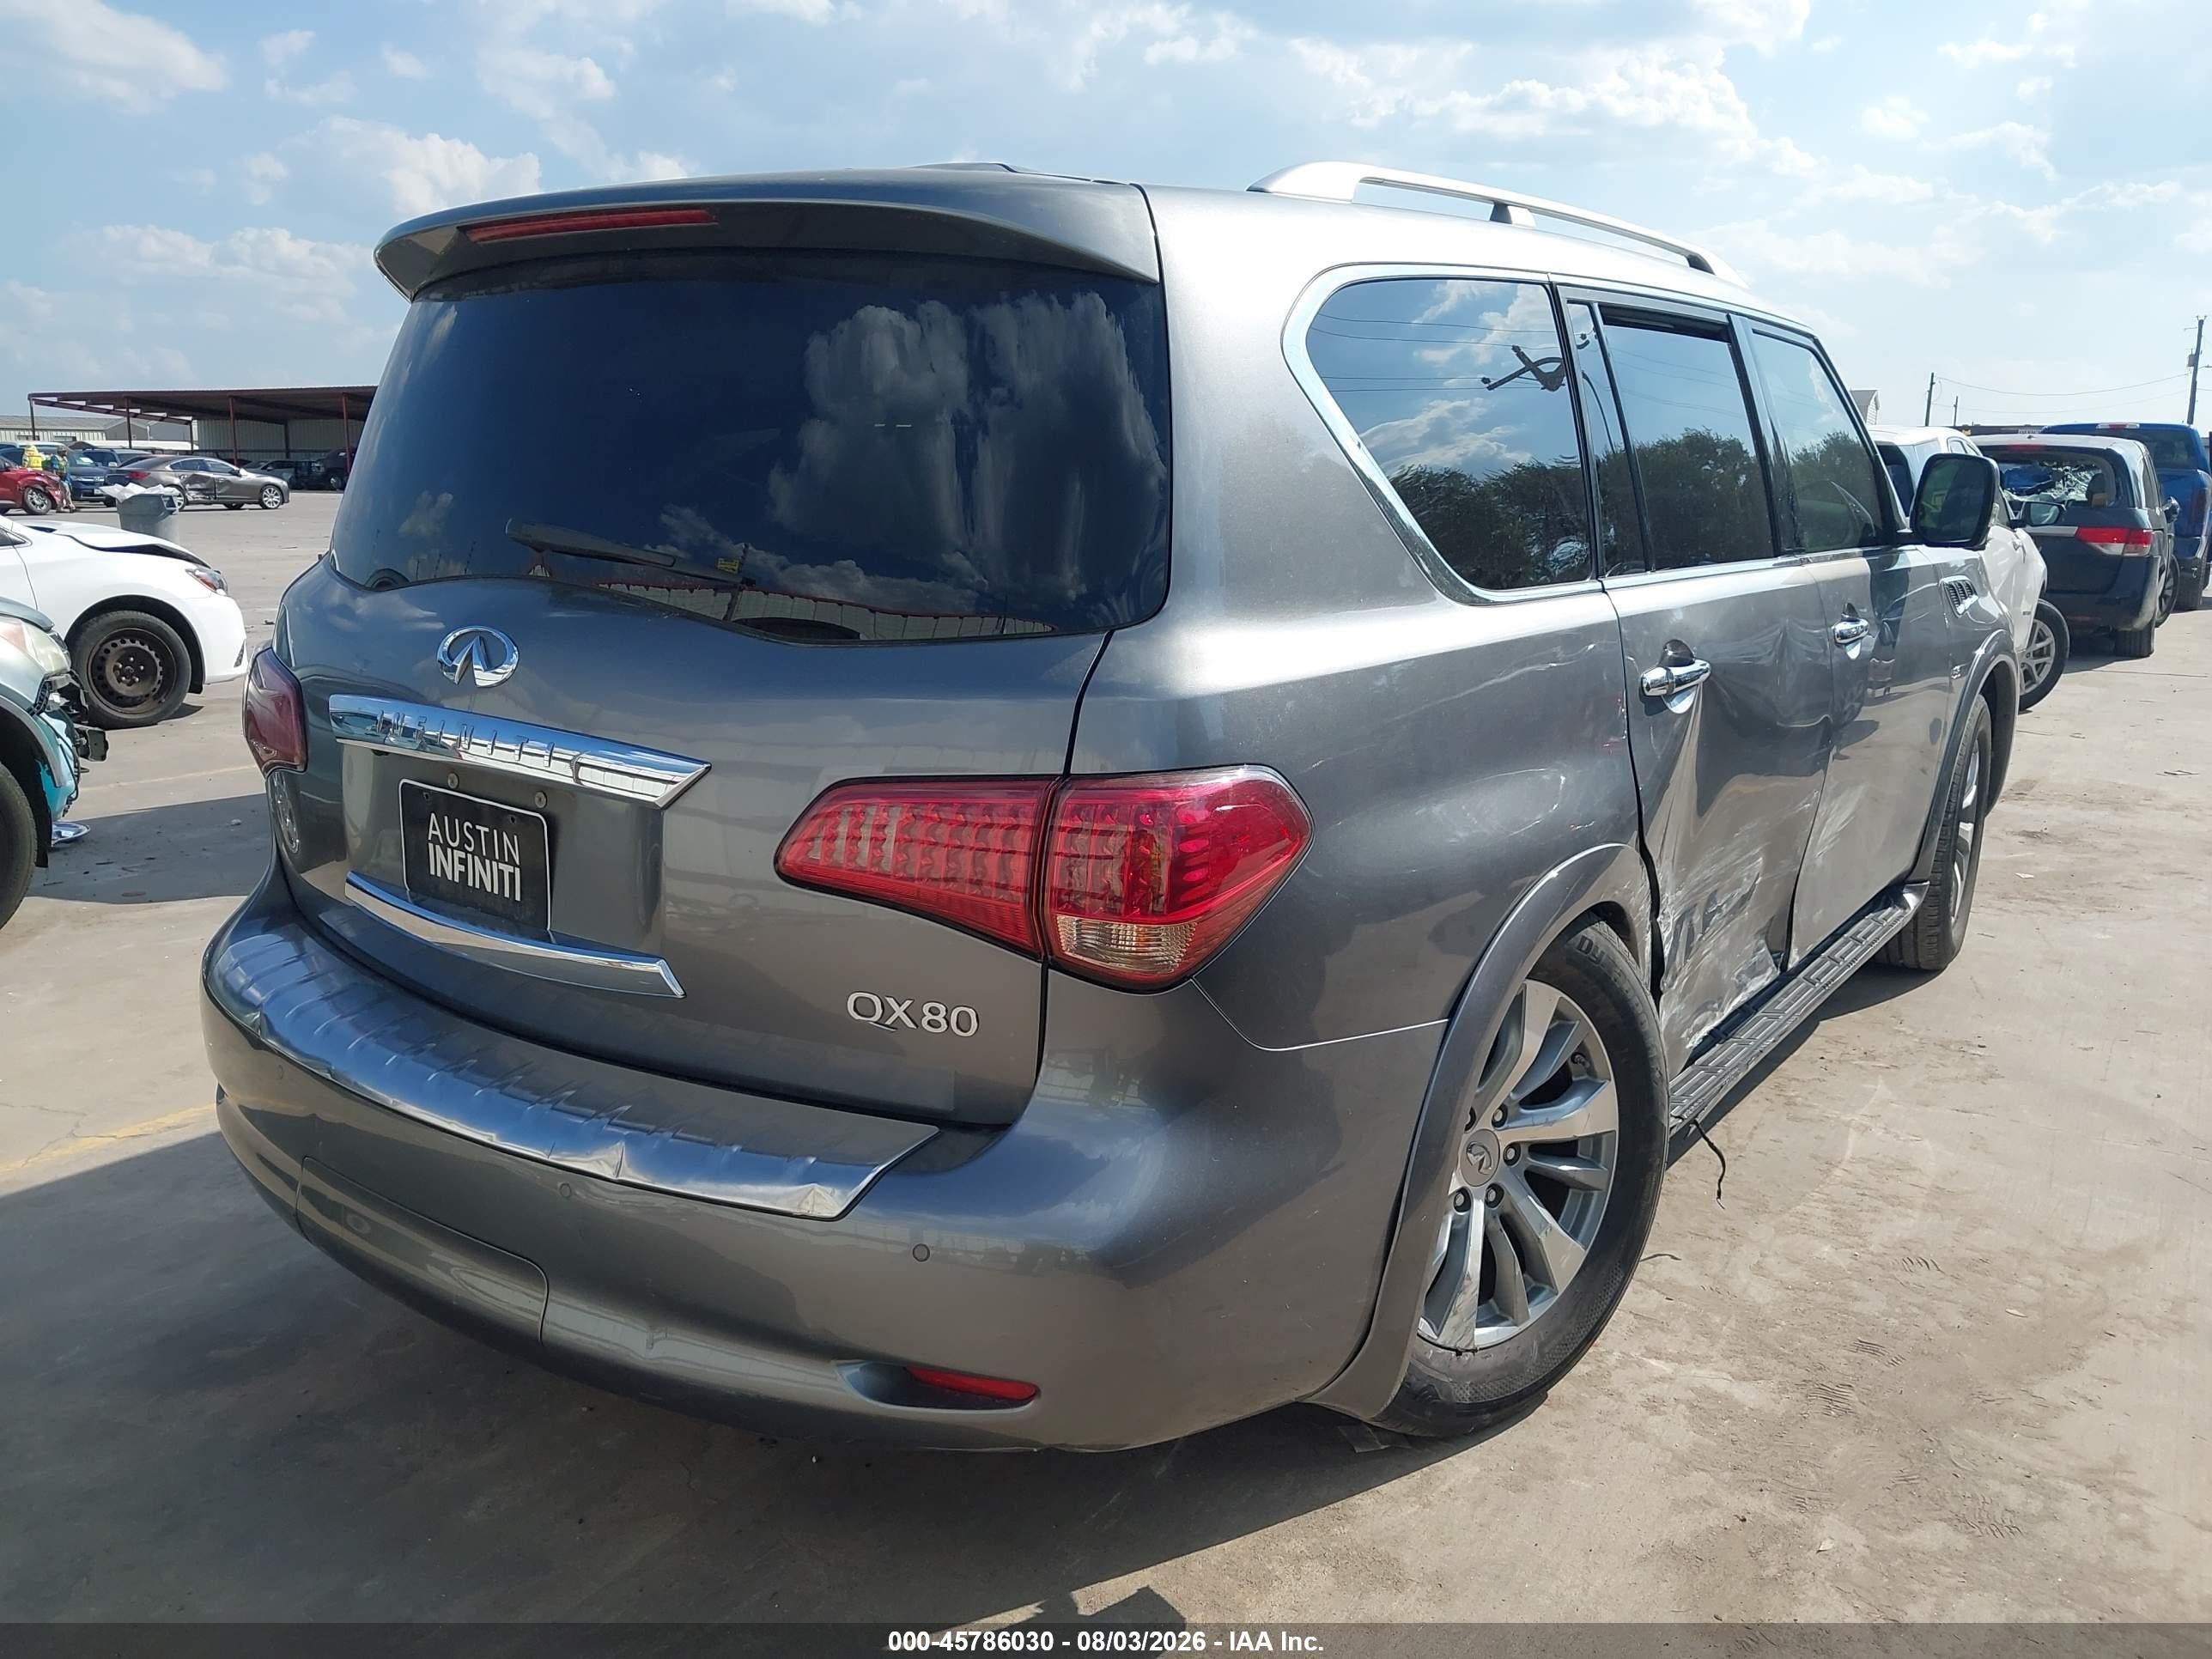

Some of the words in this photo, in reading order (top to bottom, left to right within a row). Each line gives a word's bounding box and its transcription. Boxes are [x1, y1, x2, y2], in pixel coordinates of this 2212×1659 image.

[428, 811, 520, 866] AUSTIN
[428, 842, 521, 902] INFINITI
[847, 991, 980, 1037] QX80
